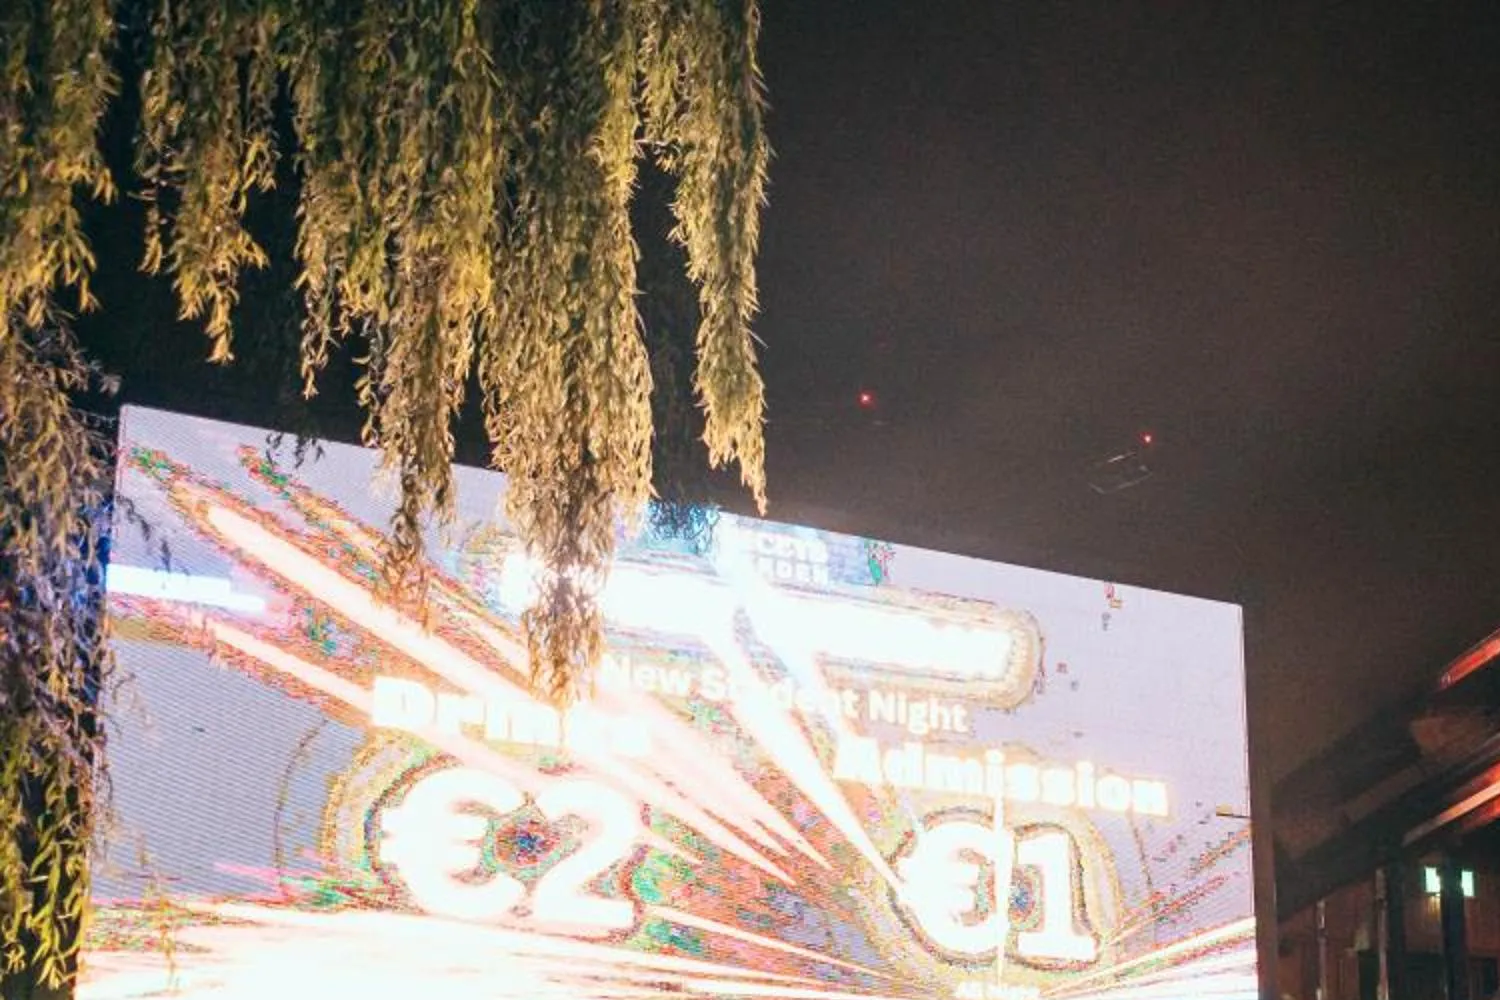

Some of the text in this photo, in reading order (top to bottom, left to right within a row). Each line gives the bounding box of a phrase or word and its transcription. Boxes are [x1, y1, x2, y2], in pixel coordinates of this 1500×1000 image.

[373, 678, 650, 758] Drin
[598, 651, 969, 735] New Sdent Night
[833, 737, 1169, 817] Admission
[376, 765, 636, 930] €2
[905, 820, 1097, 962] €1
